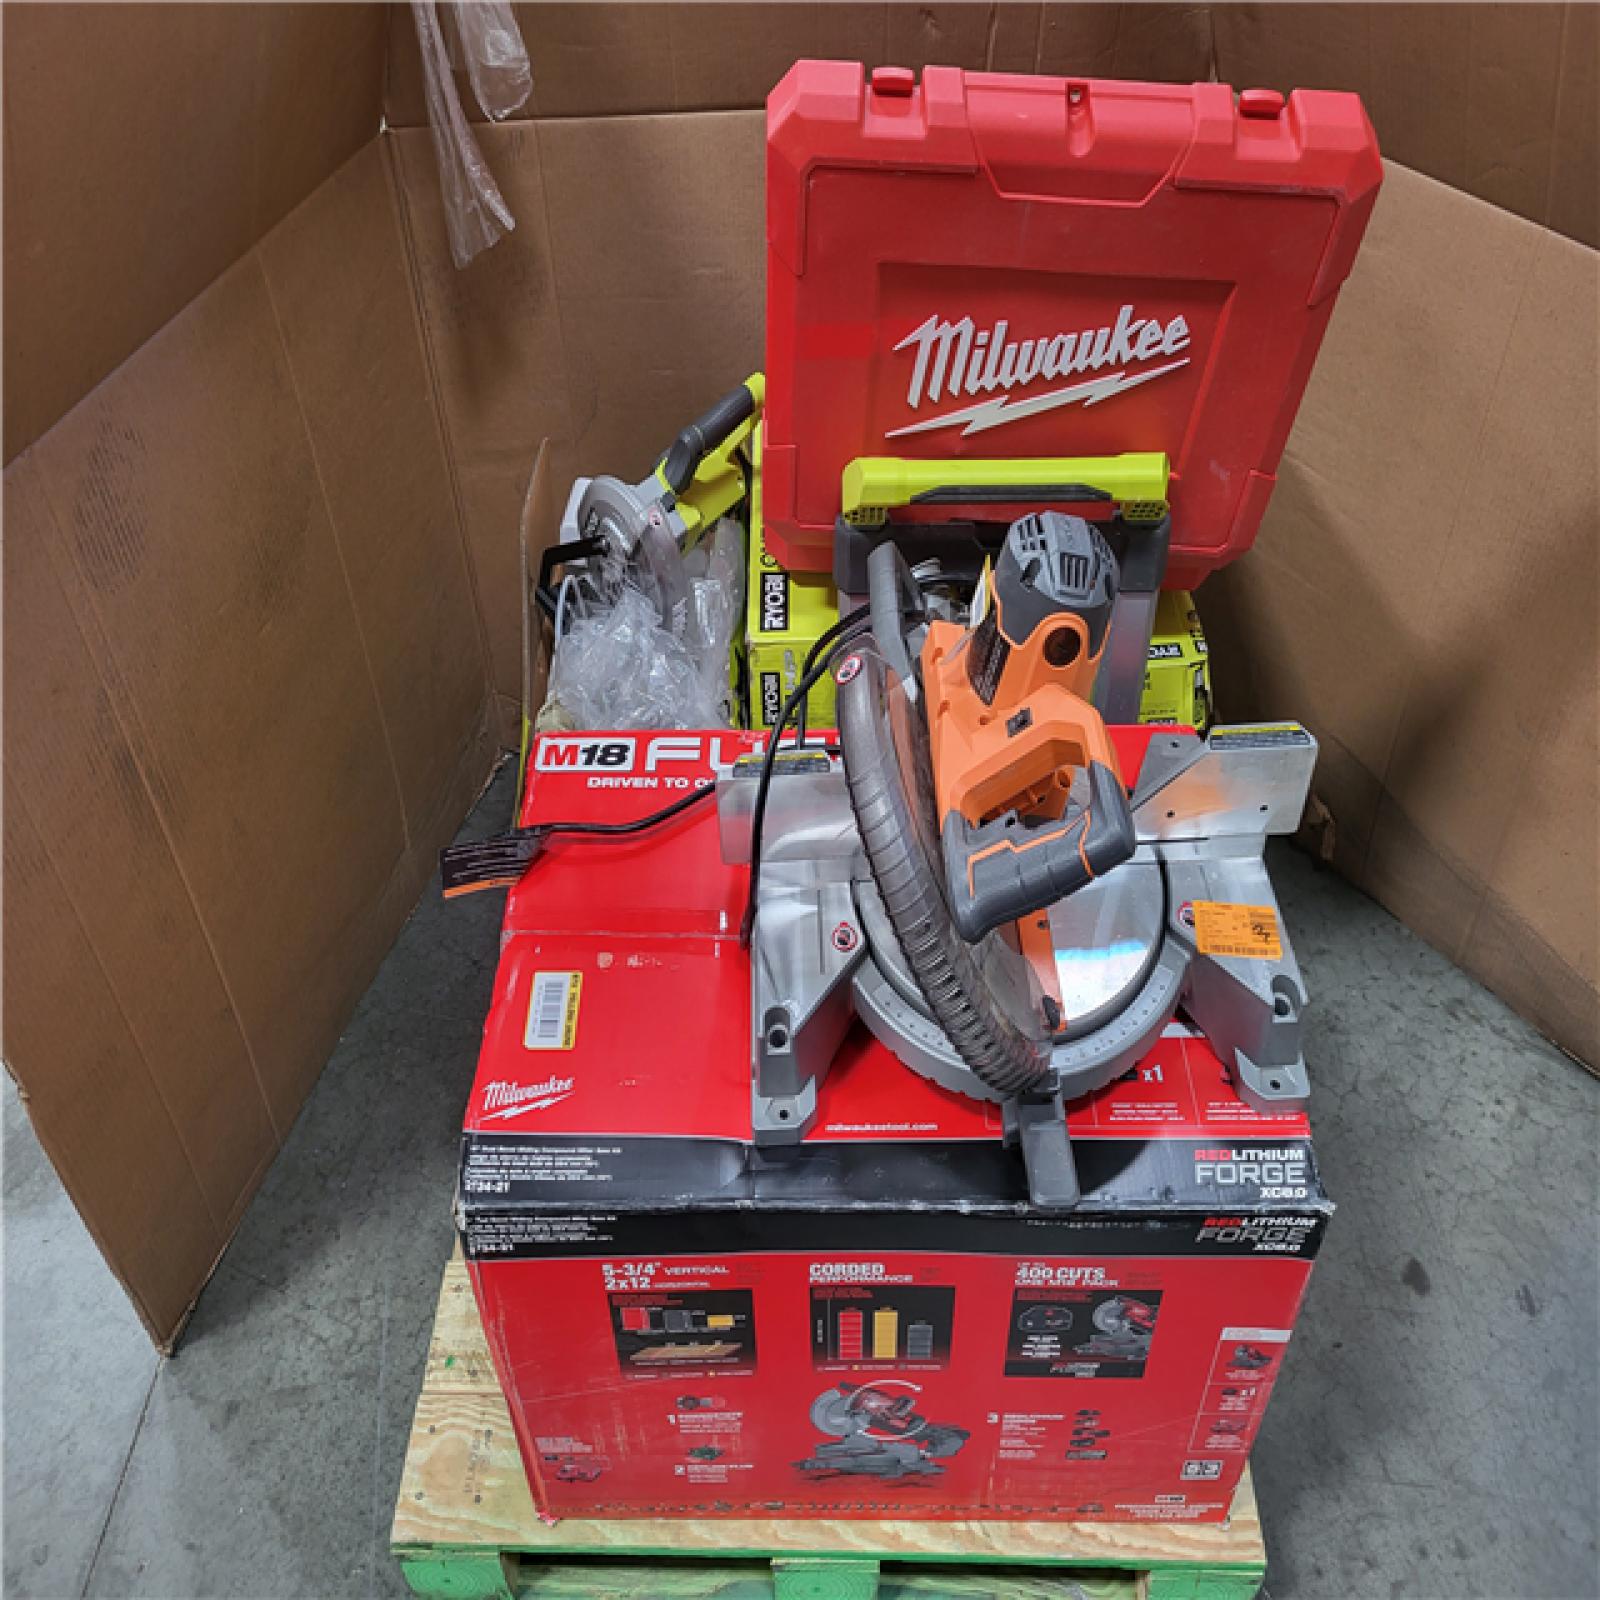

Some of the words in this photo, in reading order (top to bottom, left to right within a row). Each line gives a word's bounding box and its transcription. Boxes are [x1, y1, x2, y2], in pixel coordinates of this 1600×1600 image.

[892, 305, 1190, 409] Milwaukee
[542, 743, 631, 765] M18
[586, 777, 658, 789] DRIVEN
[664, 777, 690, 789] TO
[482, 1075, 576, 1111] Milwaukee
[1195, 1162, 1306, 1184] FORGE
[809, 1263, 885, 1276] CORDED
[1016, 1267, 1053, 1279] 400
[1057, 1267, 1105, 1279] CUTS
